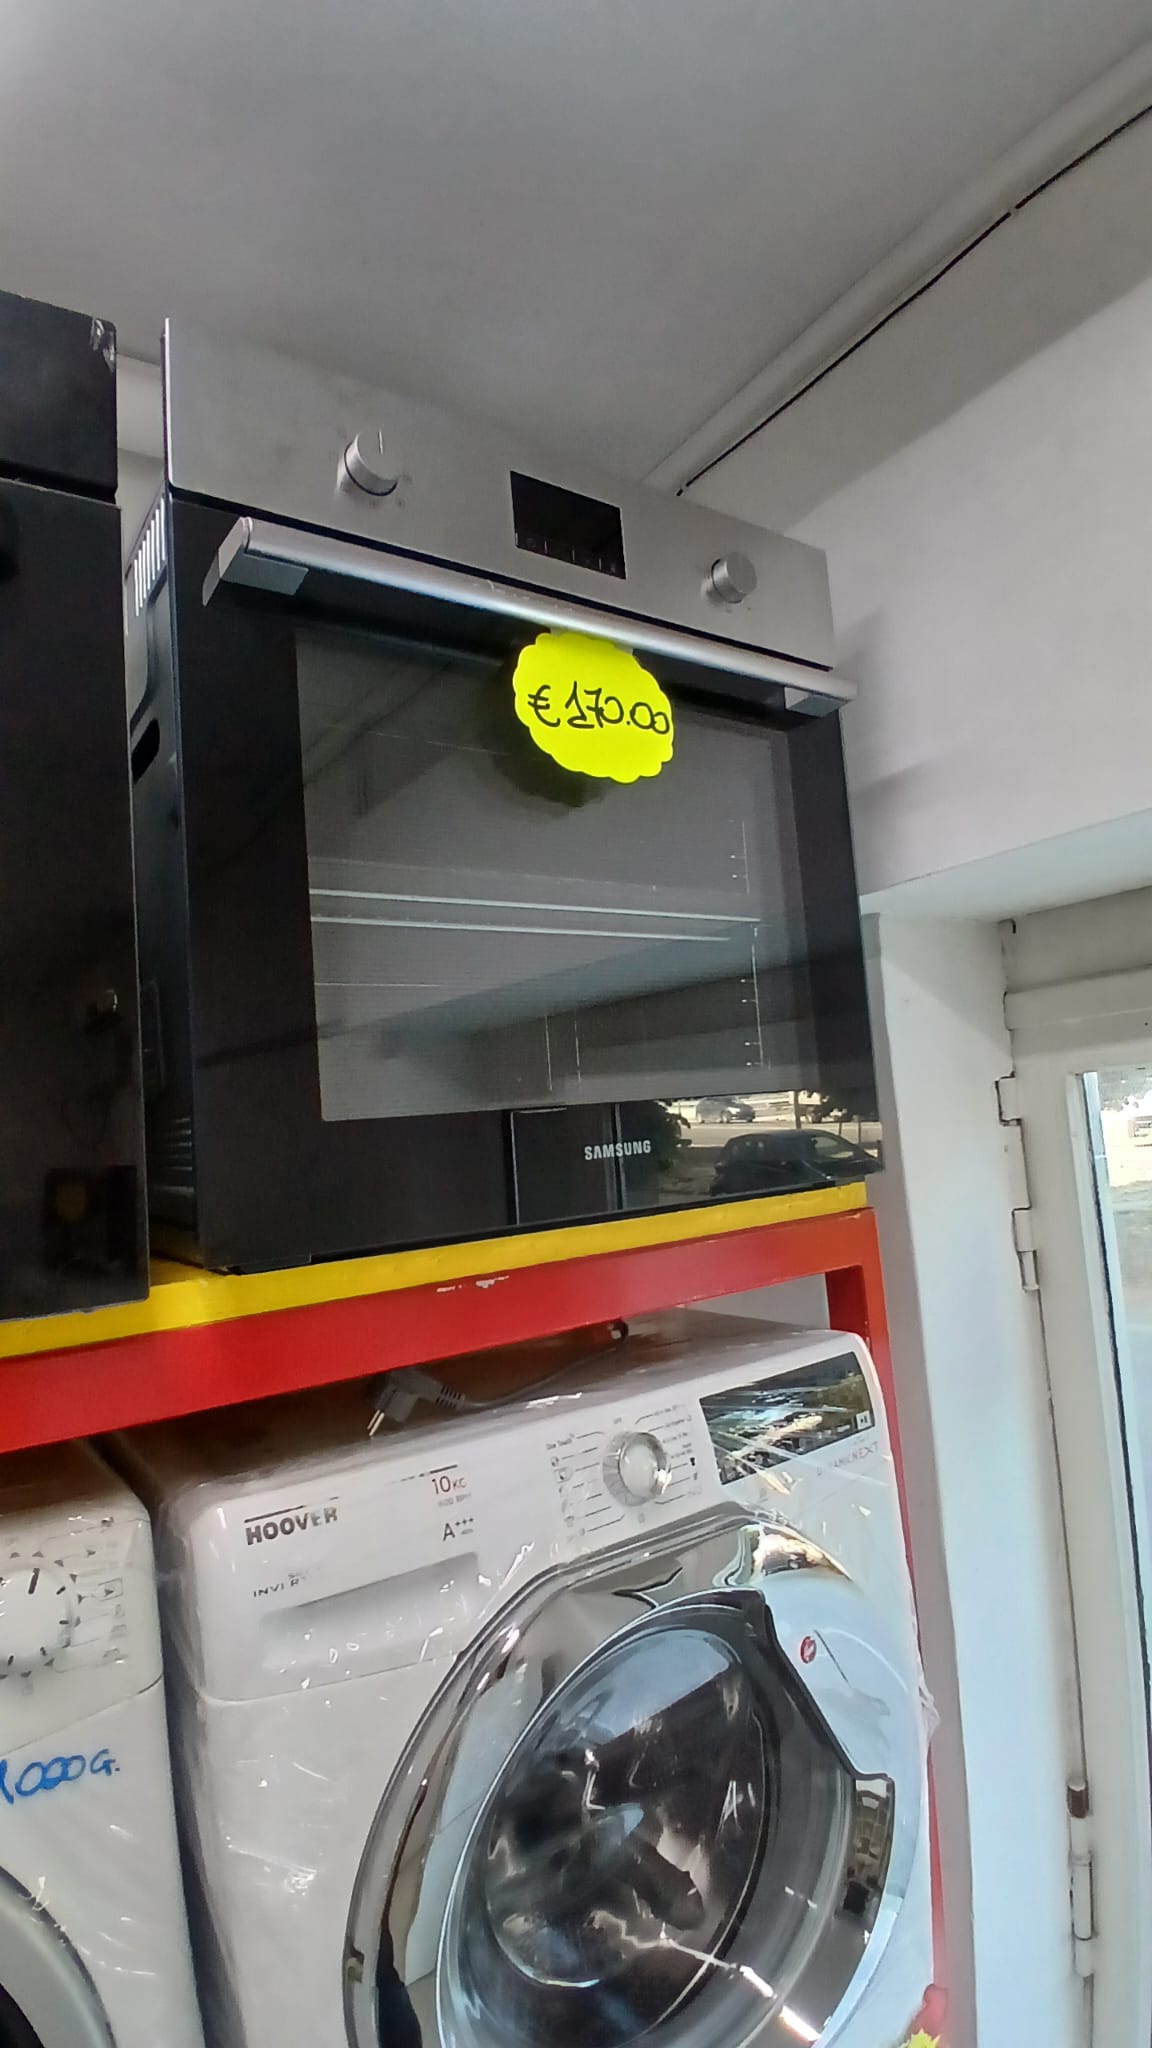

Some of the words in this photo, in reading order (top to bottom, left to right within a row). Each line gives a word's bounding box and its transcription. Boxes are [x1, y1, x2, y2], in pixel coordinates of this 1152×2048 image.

[527, 684, 561, 728] €
[564, 680, 671, 735] 170.00
[584, 1139, 652, 1161] SAMSUNG
[245, 1506, 339, 1546] HOOVER
